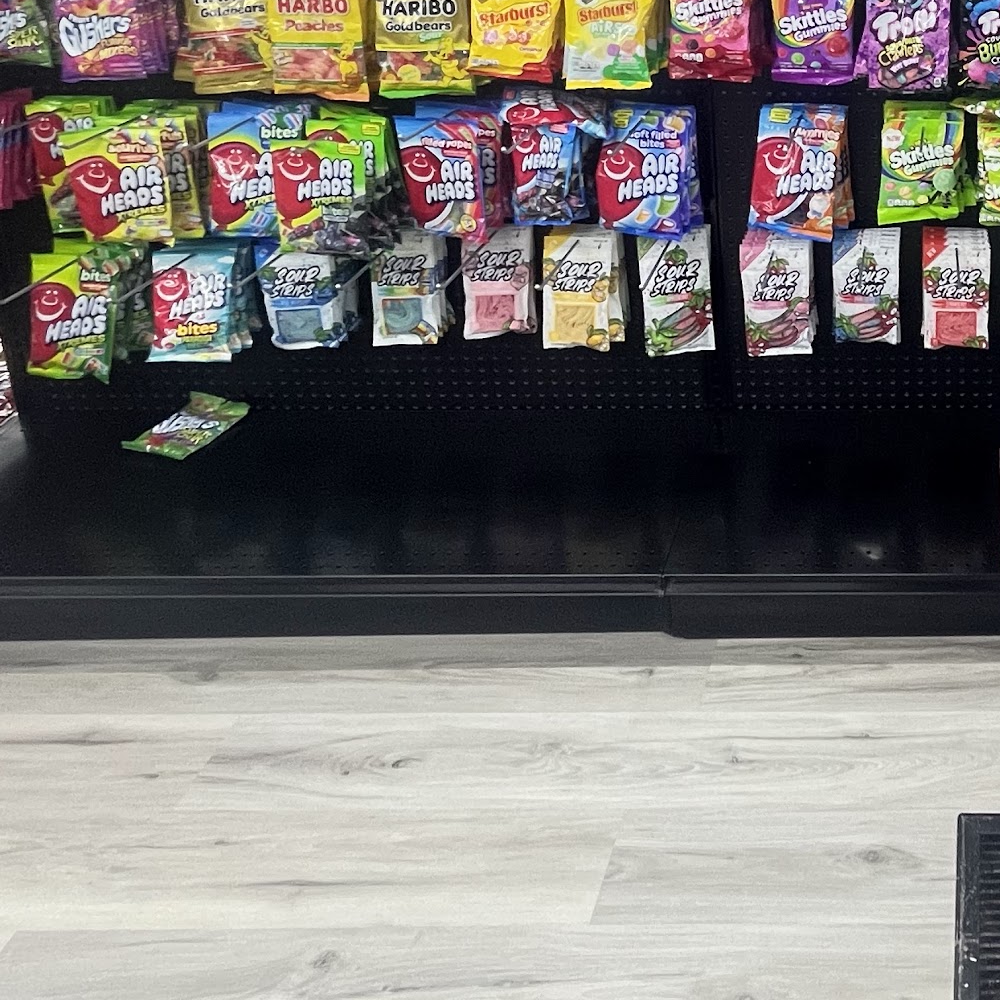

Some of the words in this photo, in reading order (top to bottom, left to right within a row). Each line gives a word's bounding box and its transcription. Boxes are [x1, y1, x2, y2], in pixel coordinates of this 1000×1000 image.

[382, 0, 456, 17] HARIBO
[479, 0, 551, 27] Starburst
[579, 0, 637, 23] Starburst
[284, 19, 344, 32] Peaches
[385, 22, 451, 32] Goldbears
[779, 8, 848, 34] Skittles
[872, 1, 938, 42] Trolli
[59, 14, 131, 57] Gushers
[793, 22, 848, 41] Gummies
[260, 125, 298, 139] bites
[651, 129, 677, 140] filled
[640, 139, 665, 149] bites
[641, 153, 680, 178] AIR
[800, 150, 837, 173] AIR
[889, 144, 955, 169] Skittles
[120, 164, 163, 187] AIR
[319, 159, 352, 179] AIR
[440, 159, 473, 182] AIR
[297, 179, 353, 201] HEADS
[426, 181, 475, 204] HEADS
[618, 173, 679, 202] HEADS
[776, 171, 834, 197] HEADS
[101, 185, 164, 216] HEADS
[383, 255, 426, 273] SOUR
[477, 250, 522, 267] SOUR
[81, 270, 110, 282] bites
[274, 266, 321, 284] SOUR
[378, 272, 420, 286] STRIPS
[470, 266, 515, 282] STRIPS
[558, 260, 603, 279] SOUR
[657, 260, 700, 280] SOUR
[270, 284, 316, 299] STRIPS
[553, 277, 596, 292] STRIPS
[651, 278, 695, 297] STRIPS
[932, 285, 977, 299] STRIPS
[71, 294, 108, 318] AIR
[46, 316, 107, 343] HEADS
[176, 323, 218, 337] bites
